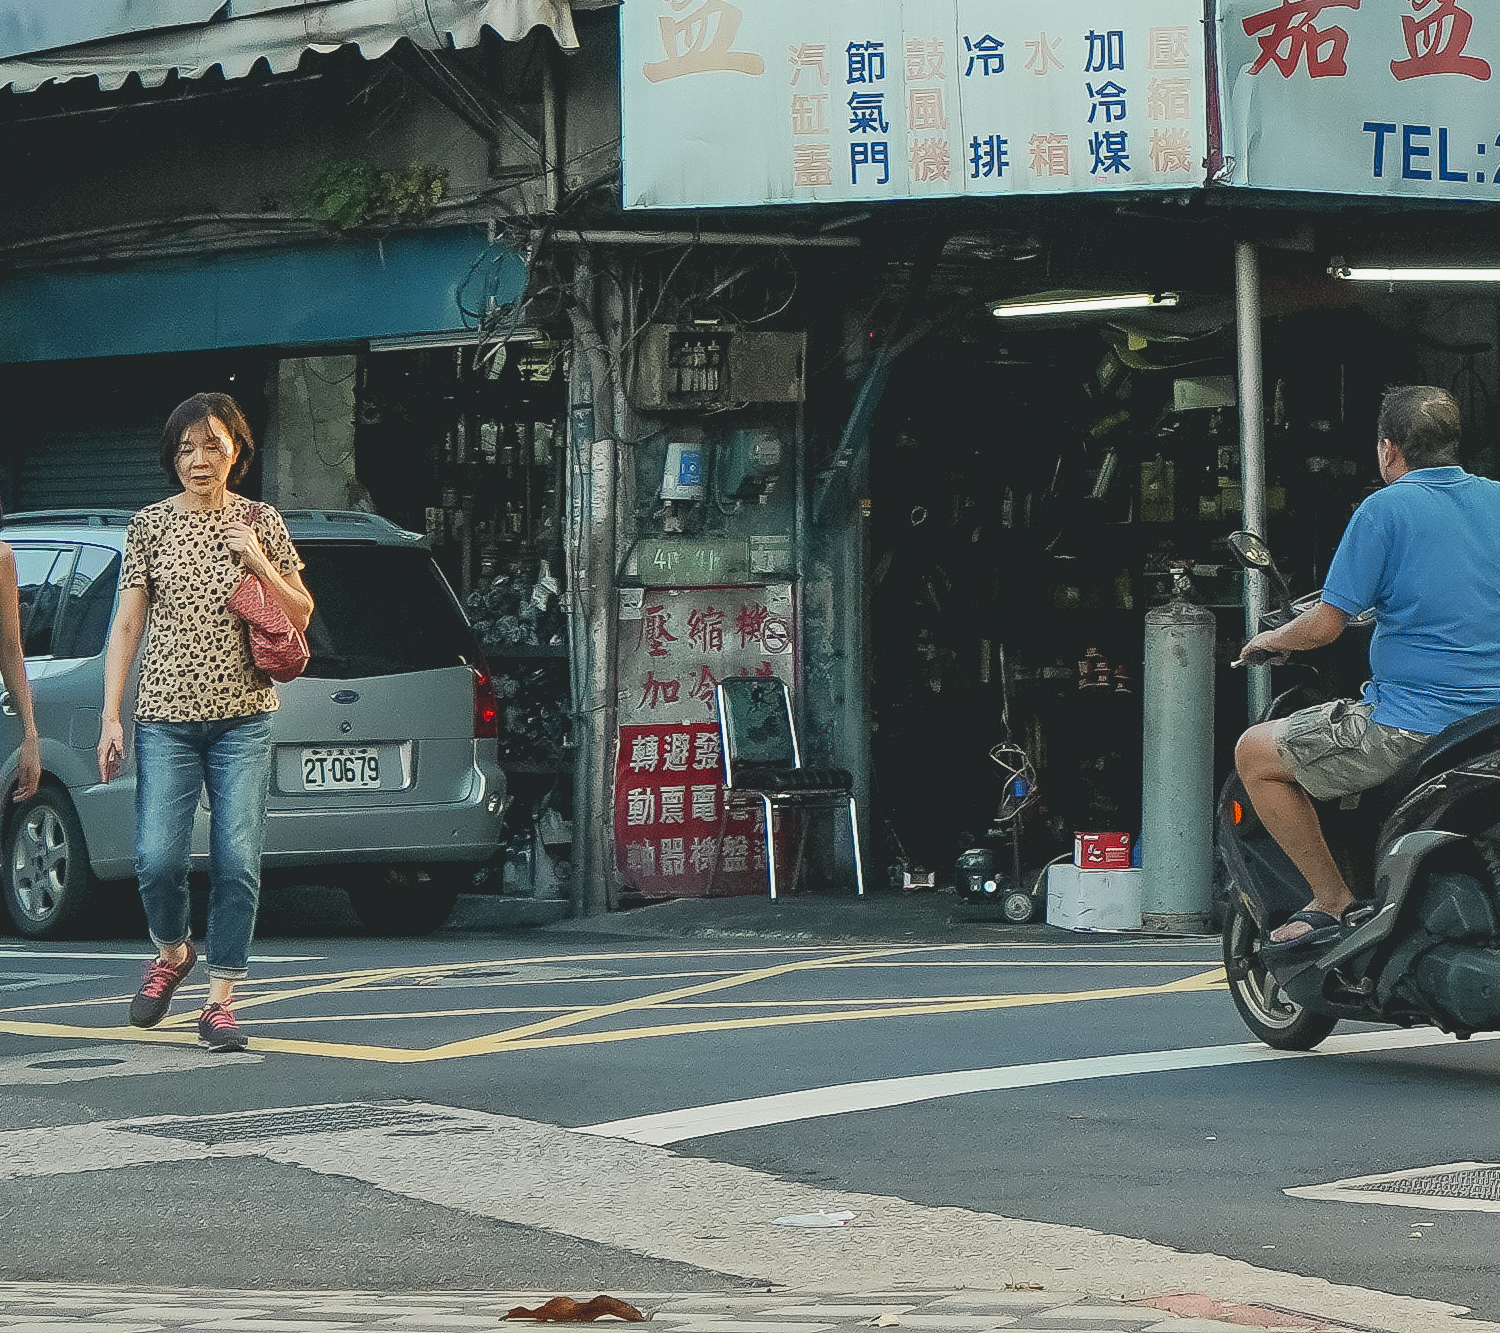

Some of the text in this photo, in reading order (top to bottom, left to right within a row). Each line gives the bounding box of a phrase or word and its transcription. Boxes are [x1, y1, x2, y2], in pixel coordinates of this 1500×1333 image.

[791, 44, 830, 187] 汽缸蓋
[845, 41, 889, 184] 節氣門
[905, 39, 951, 183] 鼓風機
[963, 34, 1011, 178] 冷排
[1024, 33, 1070, 177] 水箱
[1084, 30, 1131, 177] 加冷煤
[1147, 26, 1192, 172] 壓縮機
[304, 757, 379, 784] 2T-0679
